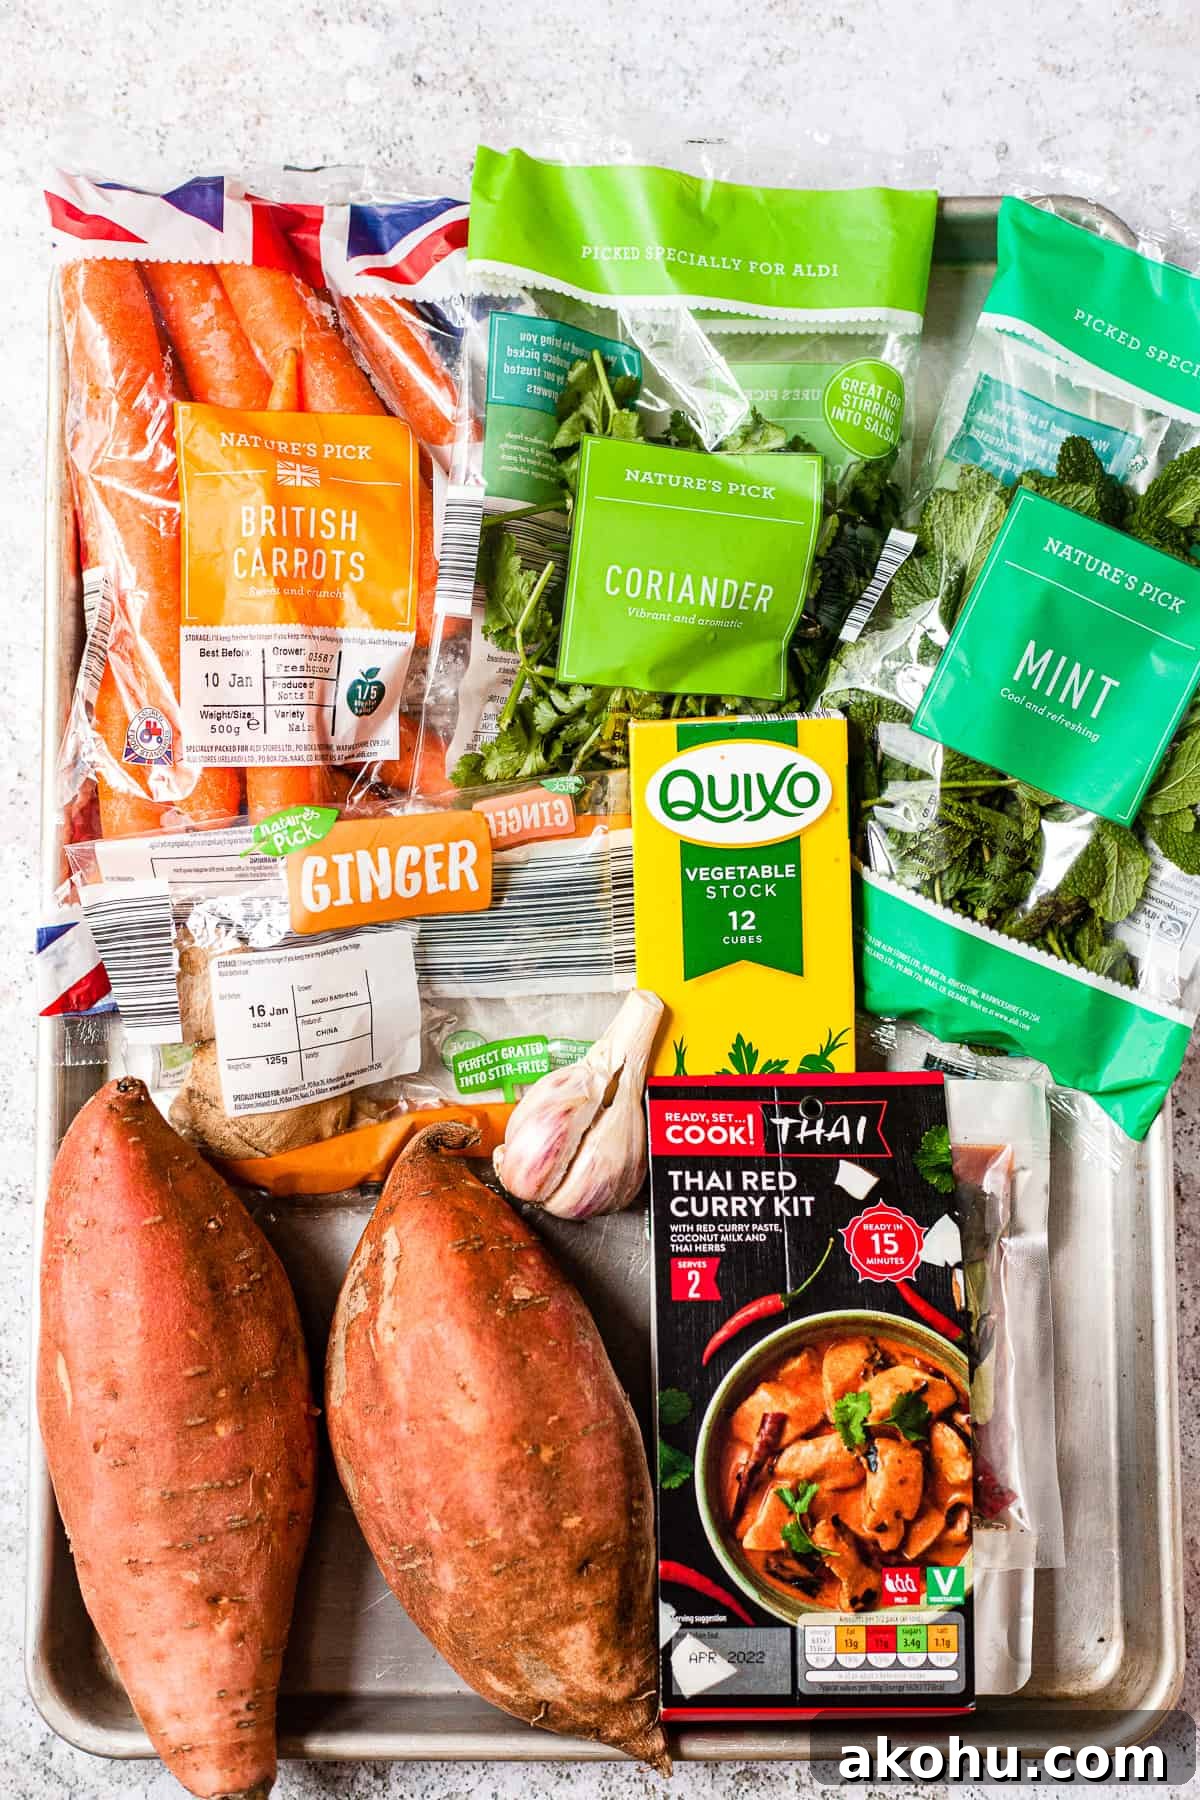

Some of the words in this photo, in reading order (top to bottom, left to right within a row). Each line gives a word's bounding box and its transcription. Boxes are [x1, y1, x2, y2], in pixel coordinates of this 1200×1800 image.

[581, 245, 640, 261] PICKED
[645, 245, 743, 271] SPECIALLY
[748, 261, 785, 276] FOR
[792, 263, 839, 277] ALDI
[1073, 308, 1142, 350] PICKED
[1145, 345, 1200, 379] SPECI
[841, 377, 883, 398] GREAT
[885, 388, 901, 411] FOR
[842, 394, 895, 425] STIRRING
[831, 405, 862, 427] INTO
[864, 416, 895, 446] SALSA
[219, 432, 317, 457] NATURE'S
[324, 444, 372, 460] PICK
[625, 468, 722, 493] NATURE'S
[728, 482, 777, 500] PICK
[241, 504, 358, 541] BRITISH
[232, 548, 366, 582] CARROTS
[1043, 537, 1139, 592] NATURE'S
[1138, 581, 1186, 614] PICK
[283, 586, 305, 596] and
[605, 564, 774, 613] CORIANDER
[627, 607, 671, 622] Vibrant
[673, 613, 696, 625] and
[698, 618, 743, 629] aromatic
[200, 648, 220, 658] Best
[272, 646, 306, 657] Grower:
[203, 672, 220, 688] 10
[228, 672, 254, 688] Jan
[1012, 639, 1121, 719] MINT
[356, 684, 378, 700] 1/5
[200, 709, 255, 722] Weight/Size:
[274, 709, 305, 721] Variety
[1000, 687, 1025, 705] Cool
[1025, 696, 1045, 715] and
[1047, 709, 1101, 743] refreshing
[210, 724, 241, 736] 500g
[214, 744, 237, 752] PACKED
[659, 762, 821, 823] QUIXO
[301, 840, 480, 913] GINGER
[685, 863, 796, 882] VEGETABLE
[706, 883, 777, 899] STOCK
[727, 910, 757, 931] 12
[722, 934, 763, 945] CUBES
[249, 1004, 266, 1018] 16
[269, 1006, 289, 1017] Jan
[315, 1026, 339, 1038] CHINA
[265, 1055, 288, 1066] 125g
[457, 1049, 500, 1073] PERFECT
[502, 1041, 543, 1060] GRATED
[459, 1072, 486, 1088] INTO
[488, 1059, 549, 1081] STIR-FRIES
[664, 1112, 710, 1125] READY,
[711, 1112, 746, 1124] SET...
[664, 1114, 755, 1145] COOK!
[769, 1114, 867, 1146] THAI
[668, 1171, 732, 1191] THAI
[742, 1171, 797, 1191] RED
[669, 1196, 765, 1217] CURRY
[774, 1196, 815, 1217] KIT
[669, 1224, 694, 1233] WITH
[696, 1224, 715, 1233] RED
[717, 1223, 750, 1232] CURRY
[751, 1223, 783, 1234] PASTE,
[863, 1223, 888, 1232] READY
[889, 1223, 903, 1231] IN
[669, 1234, 718, 1243] COCONUT
[720, 1234, 743, 1243] MILK
[745, 1233, 766, 1242] AND
[870, 1233, 899, 1255] 15
[669, 1244, 692, 1253] THAI
[694, 1243, 726, 1253] HERBS
[677, 1261, 707, 1269] SERVES
[865, 1257, 905, 1266] MINUTES
[686, 1271, 700, 1298] 2
[932, 1568, 958, 1596] V
[694, 1613, 728, 1624] suggestion
[902, 1628, 922, 1636] sugars
[844, 1639, 858, 1649] 13g
[903, 1638, 921, 1649] 3.4g
[935, 1638, 950, 1649] 1.1g
[689, 1651, 718, 1665] APR
[727, 1650, 766, 1665] 2022
